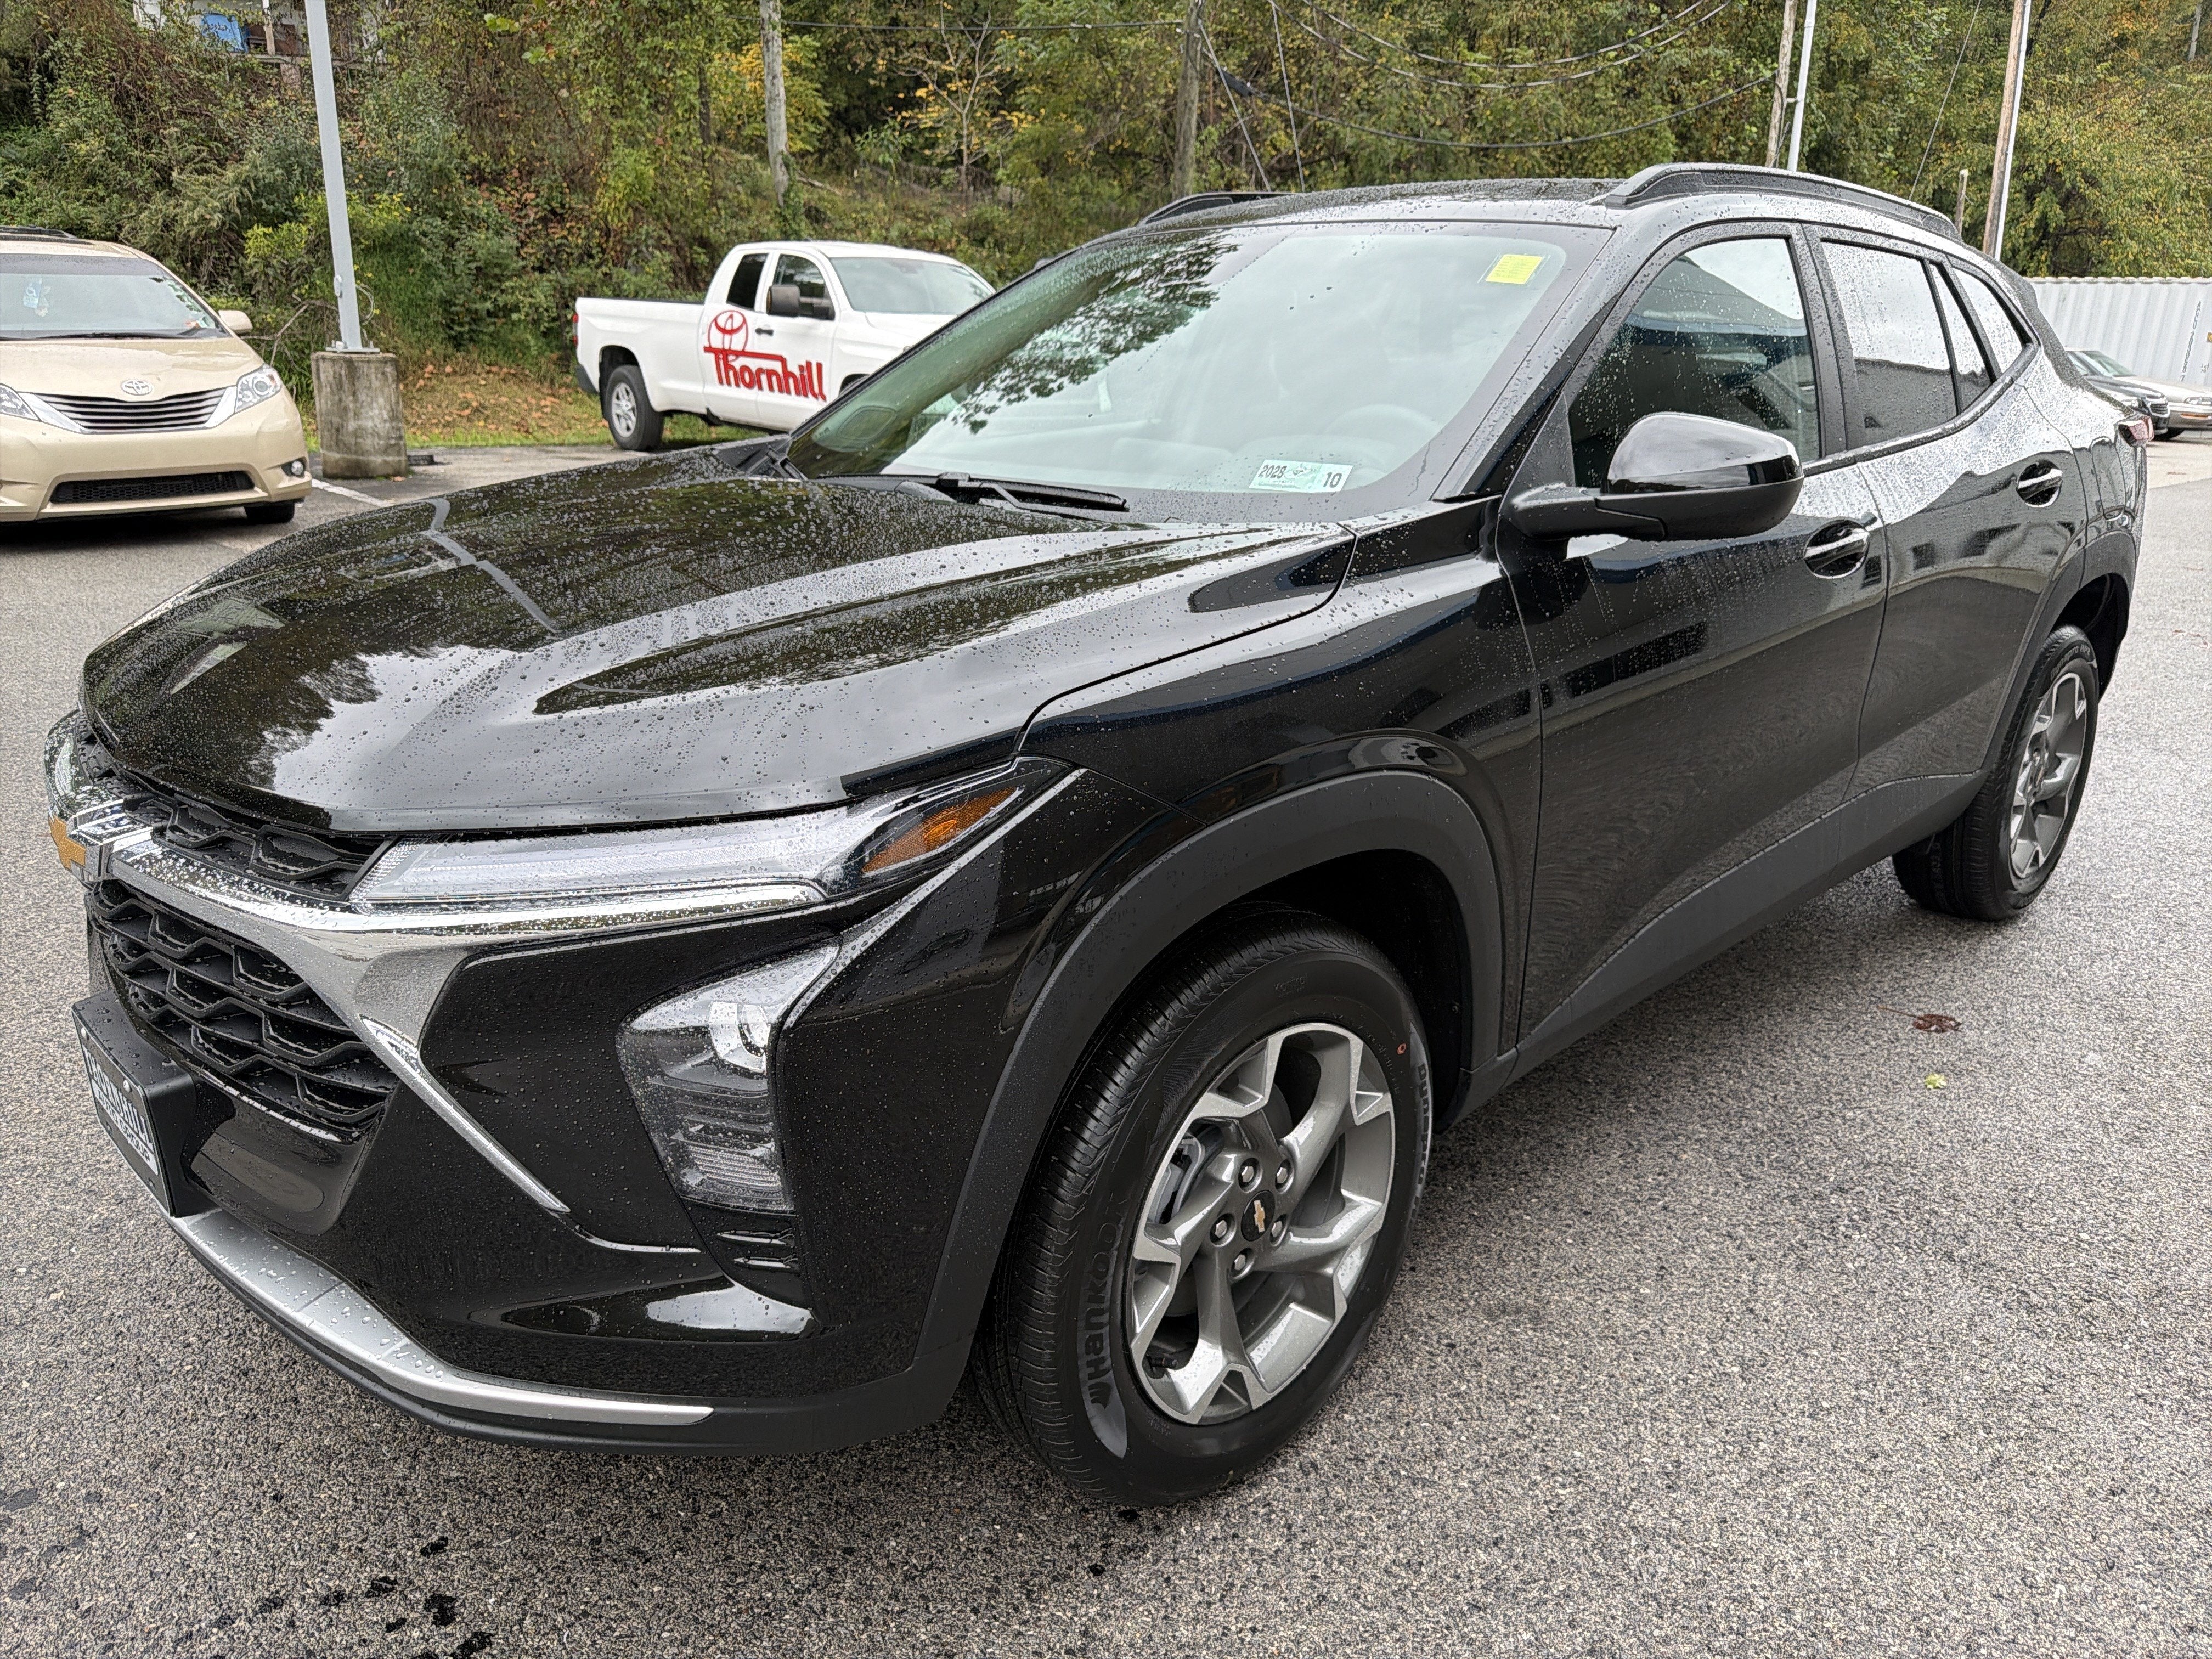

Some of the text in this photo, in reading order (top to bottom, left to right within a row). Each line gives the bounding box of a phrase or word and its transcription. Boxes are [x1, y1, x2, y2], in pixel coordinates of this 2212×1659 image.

[703, 346, 827, 402] Thornhill
[1323, 472, 1342, 488] 10
[82, 1043, 155, 1151] THORNHILL
[97, 1090, 151, 1162] AUTO GROUP
